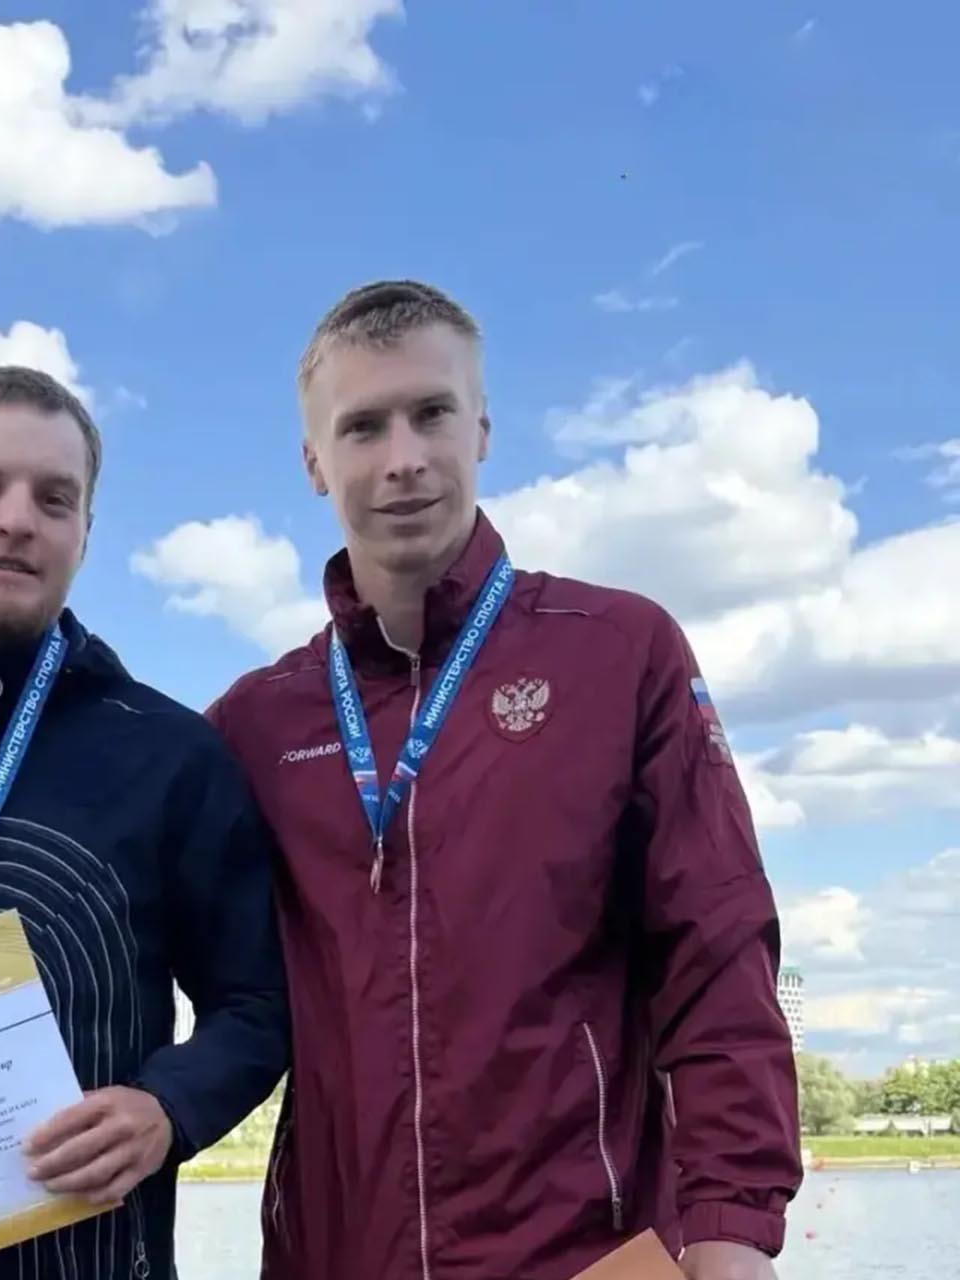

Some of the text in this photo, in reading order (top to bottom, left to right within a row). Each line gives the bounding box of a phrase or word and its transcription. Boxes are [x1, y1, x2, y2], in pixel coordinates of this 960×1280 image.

[33, 639, 62, 689] СПОРТА
[423, 626, 480, 728] МИНИСТЕРСТВО
[473, 579, 505, 629] СПОРТА
[339, 690, 361, 738] РОССИИ
